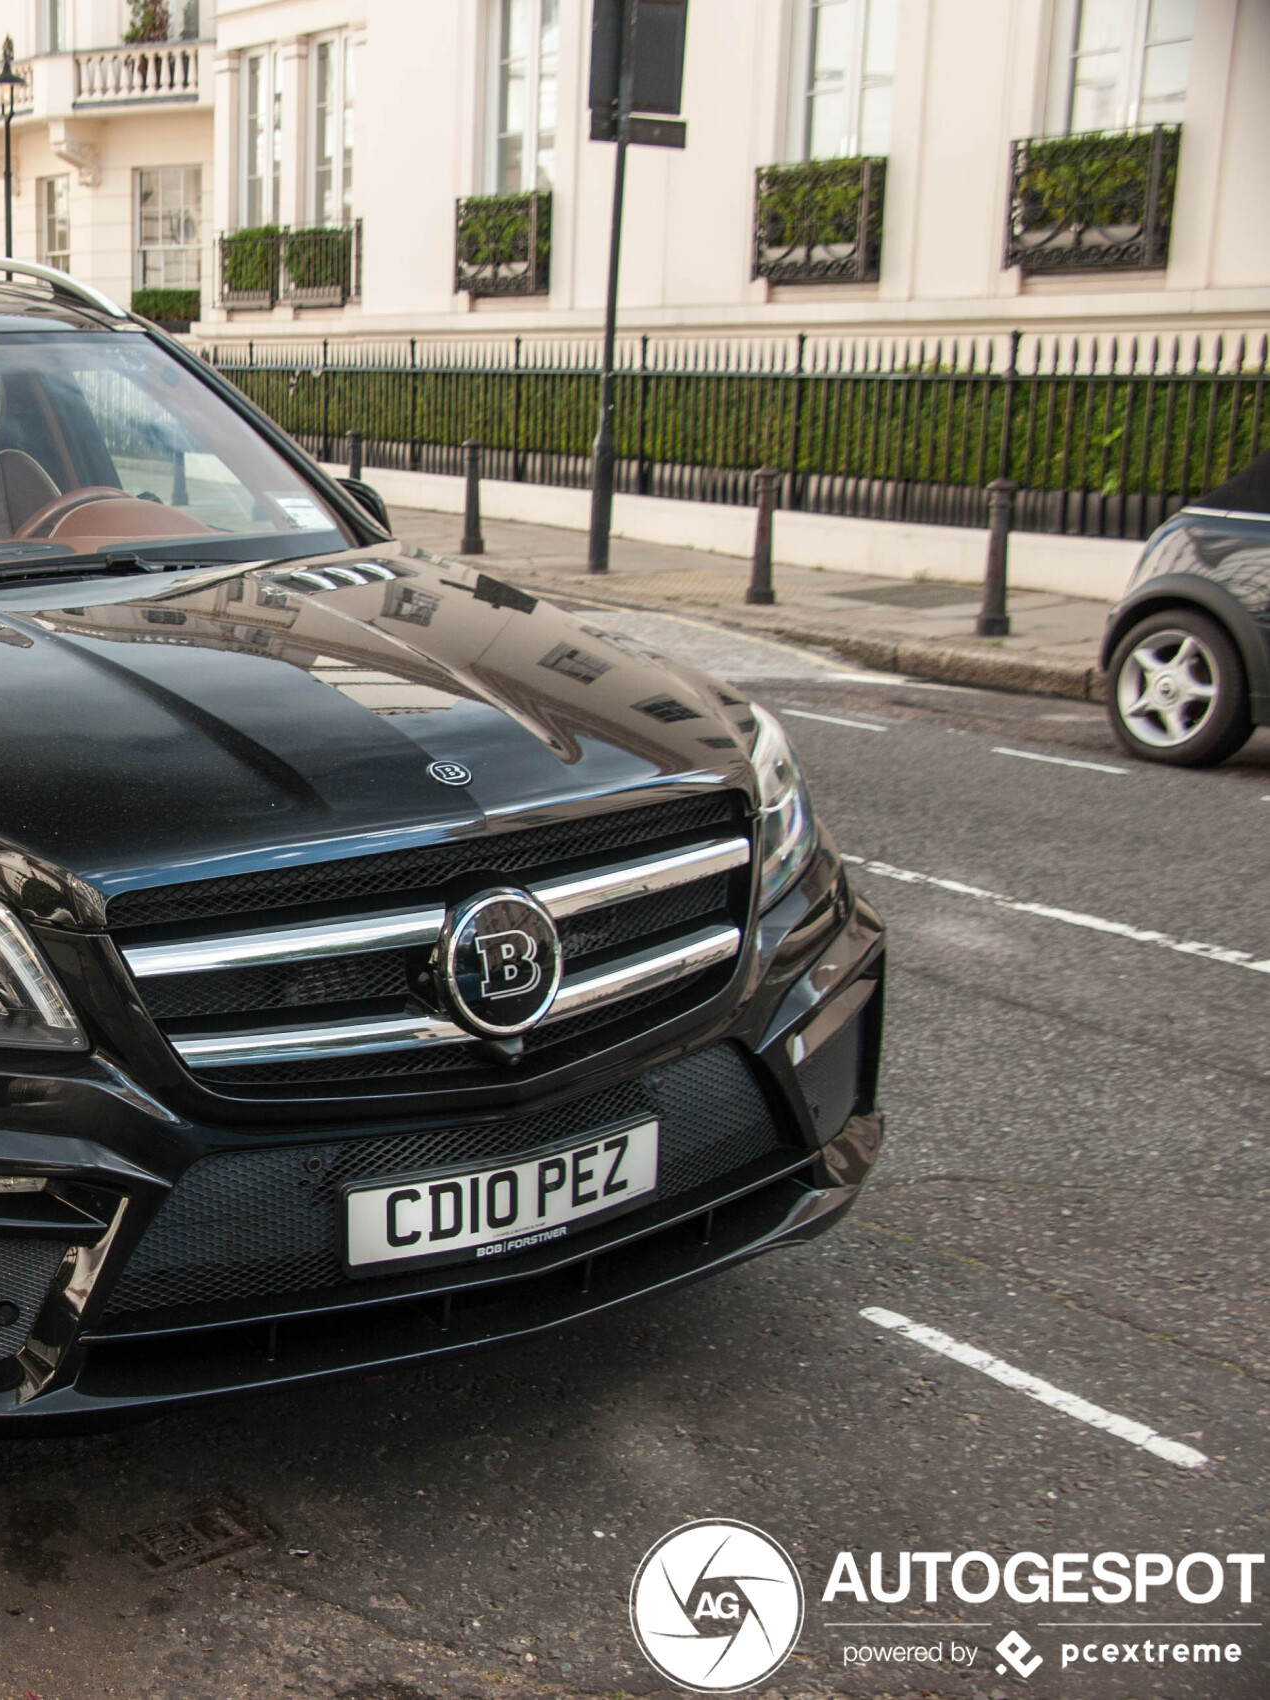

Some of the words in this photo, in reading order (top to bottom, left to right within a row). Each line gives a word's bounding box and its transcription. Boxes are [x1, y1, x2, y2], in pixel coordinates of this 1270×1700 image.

[475, 929, 541, 1000] B
[386, 1169, 519, 1248] CD10
[537, 1135, 629, 1218] PEZ
